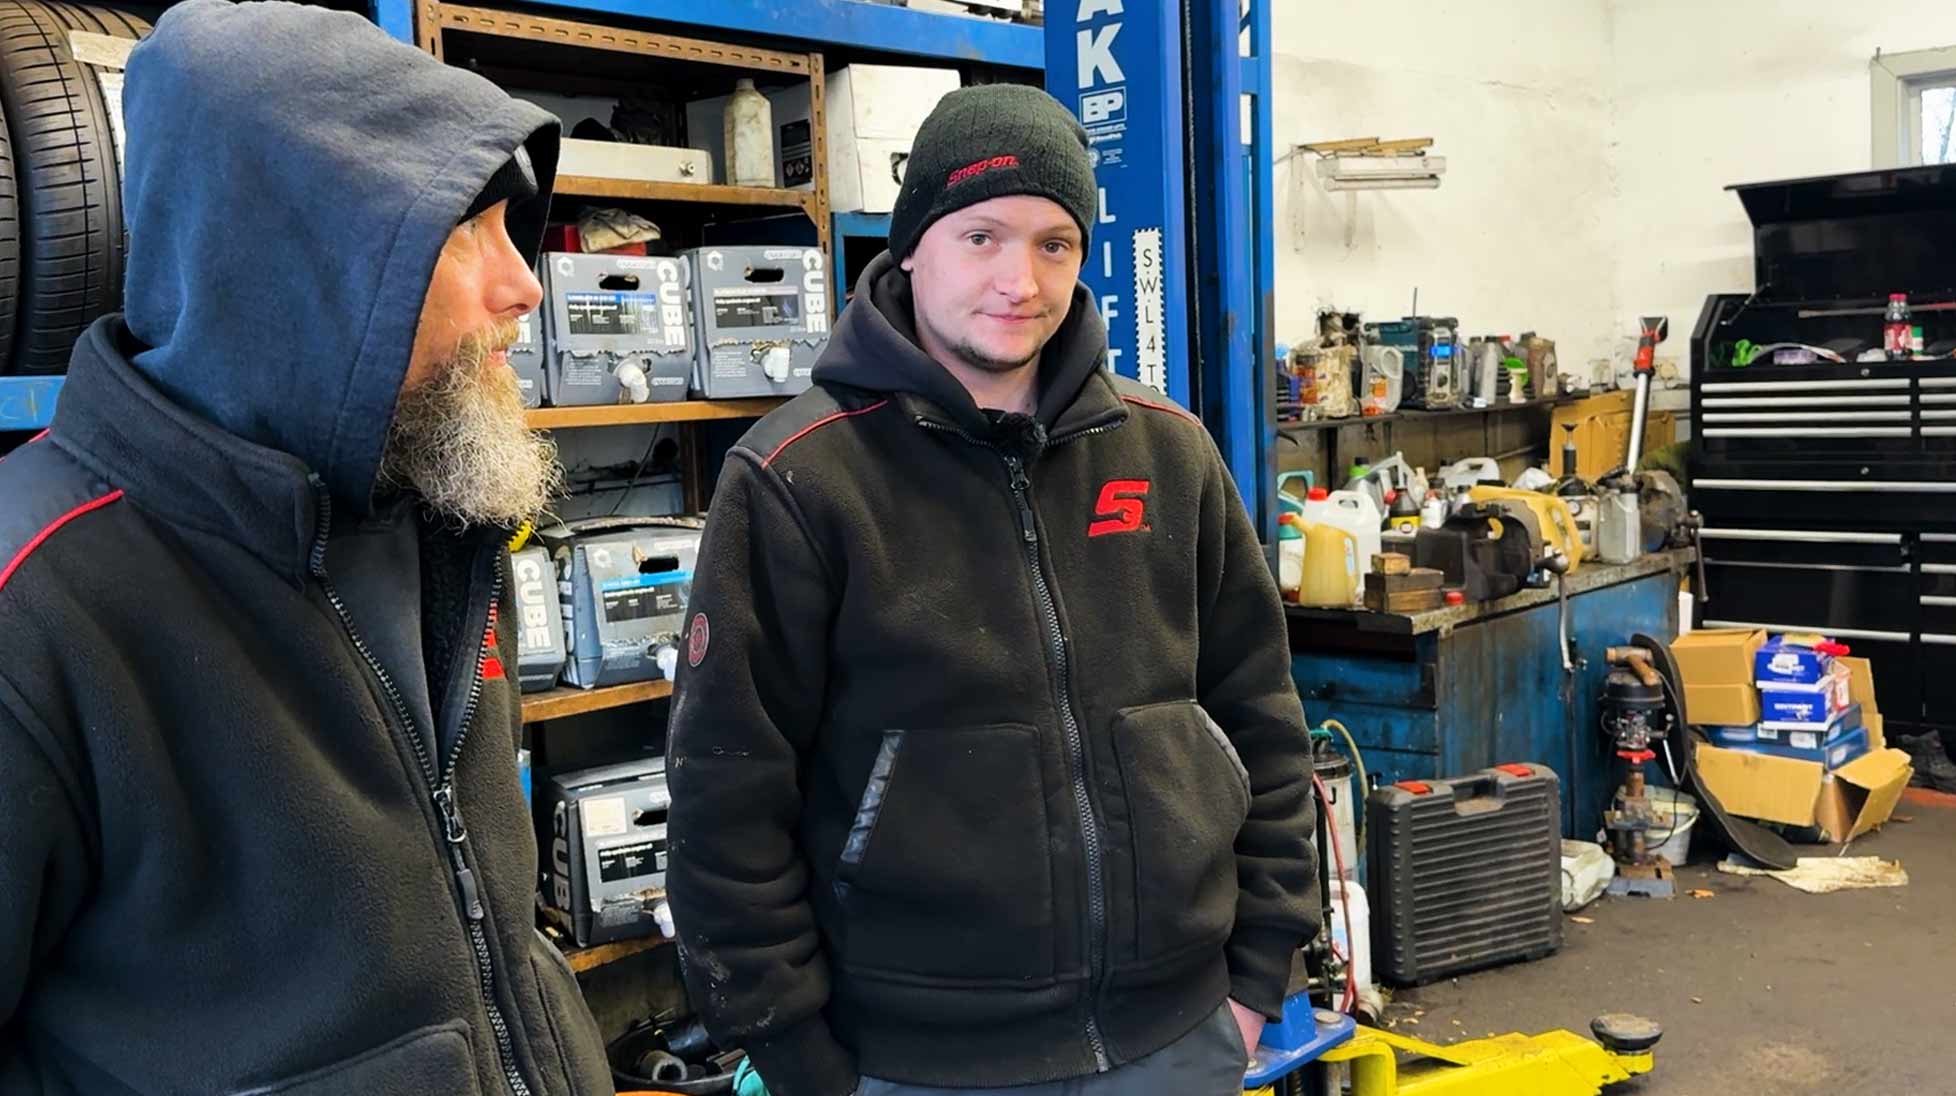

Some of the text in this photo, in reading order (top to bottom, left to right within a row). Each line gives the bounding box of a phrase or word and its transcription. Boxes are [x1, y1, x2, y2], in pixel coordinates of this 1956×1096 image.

[1082, 91, 1124, 124] BP
[656, 260, 686, 346] CUBE
[802, 248, 828, 334] CUBE
[1145, 335, 1156, 353] 4
[516, 559, 552, 649] CUBE
